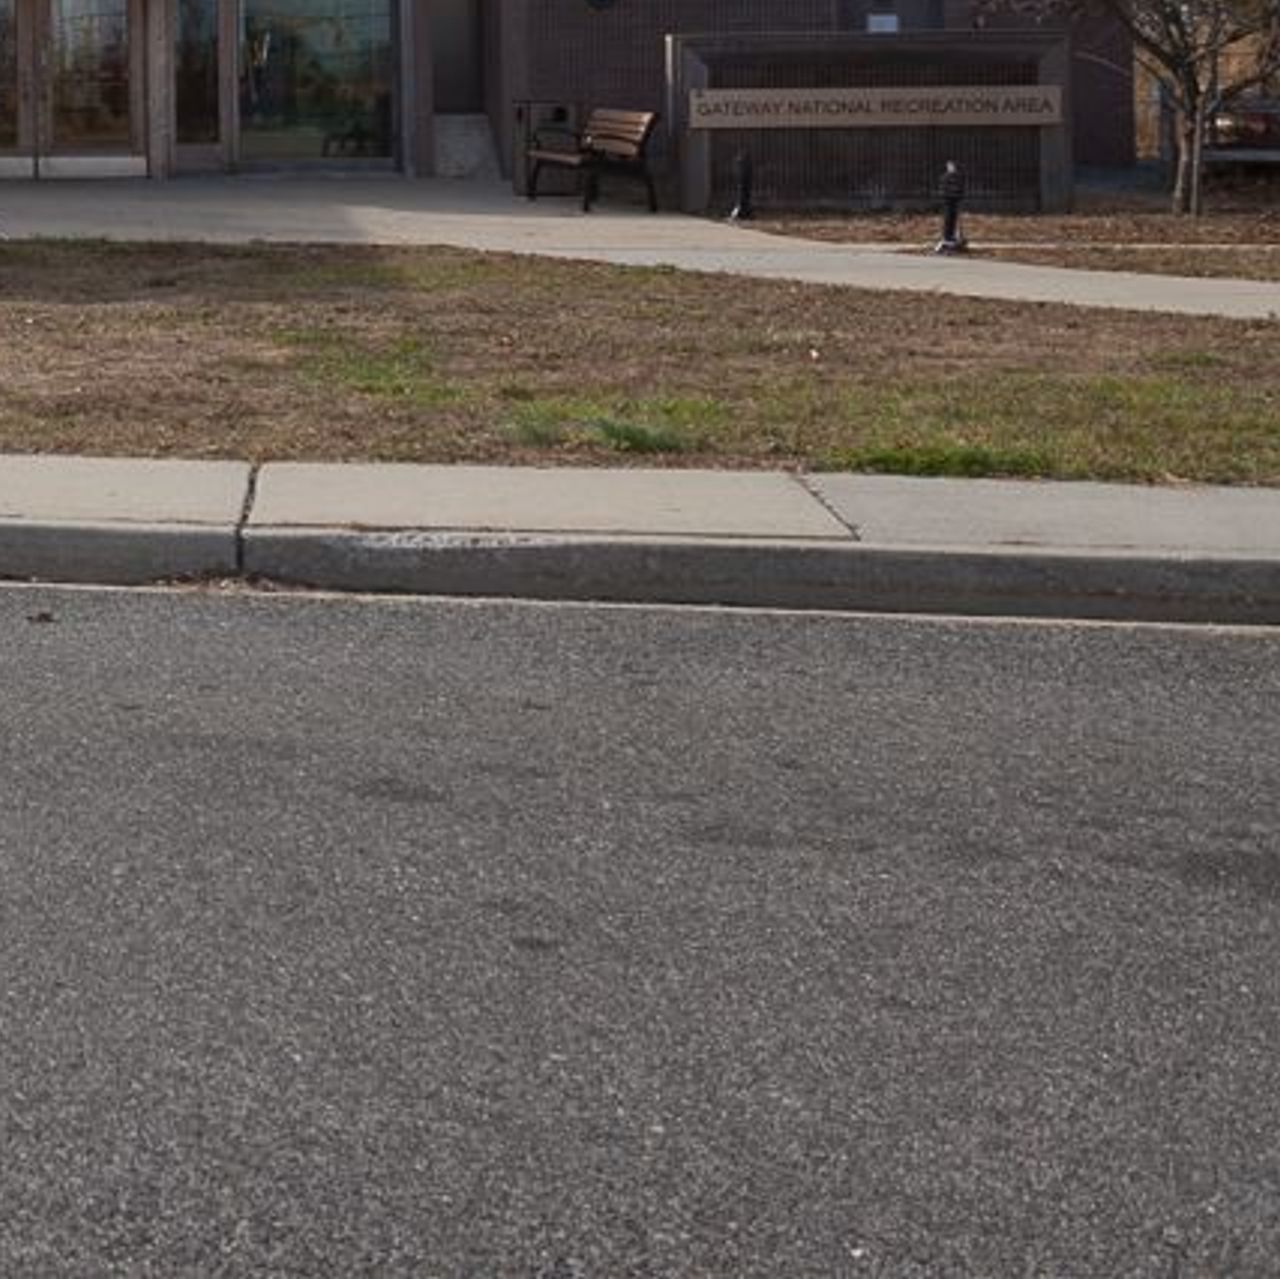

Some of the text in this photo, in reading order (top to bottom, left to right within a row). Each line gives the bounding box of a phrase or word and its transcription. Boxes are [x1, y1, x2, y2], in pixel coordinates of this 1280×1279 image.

[696, 96, 1054, 118] GATEWAY NATIONAL RECREATION AREA
